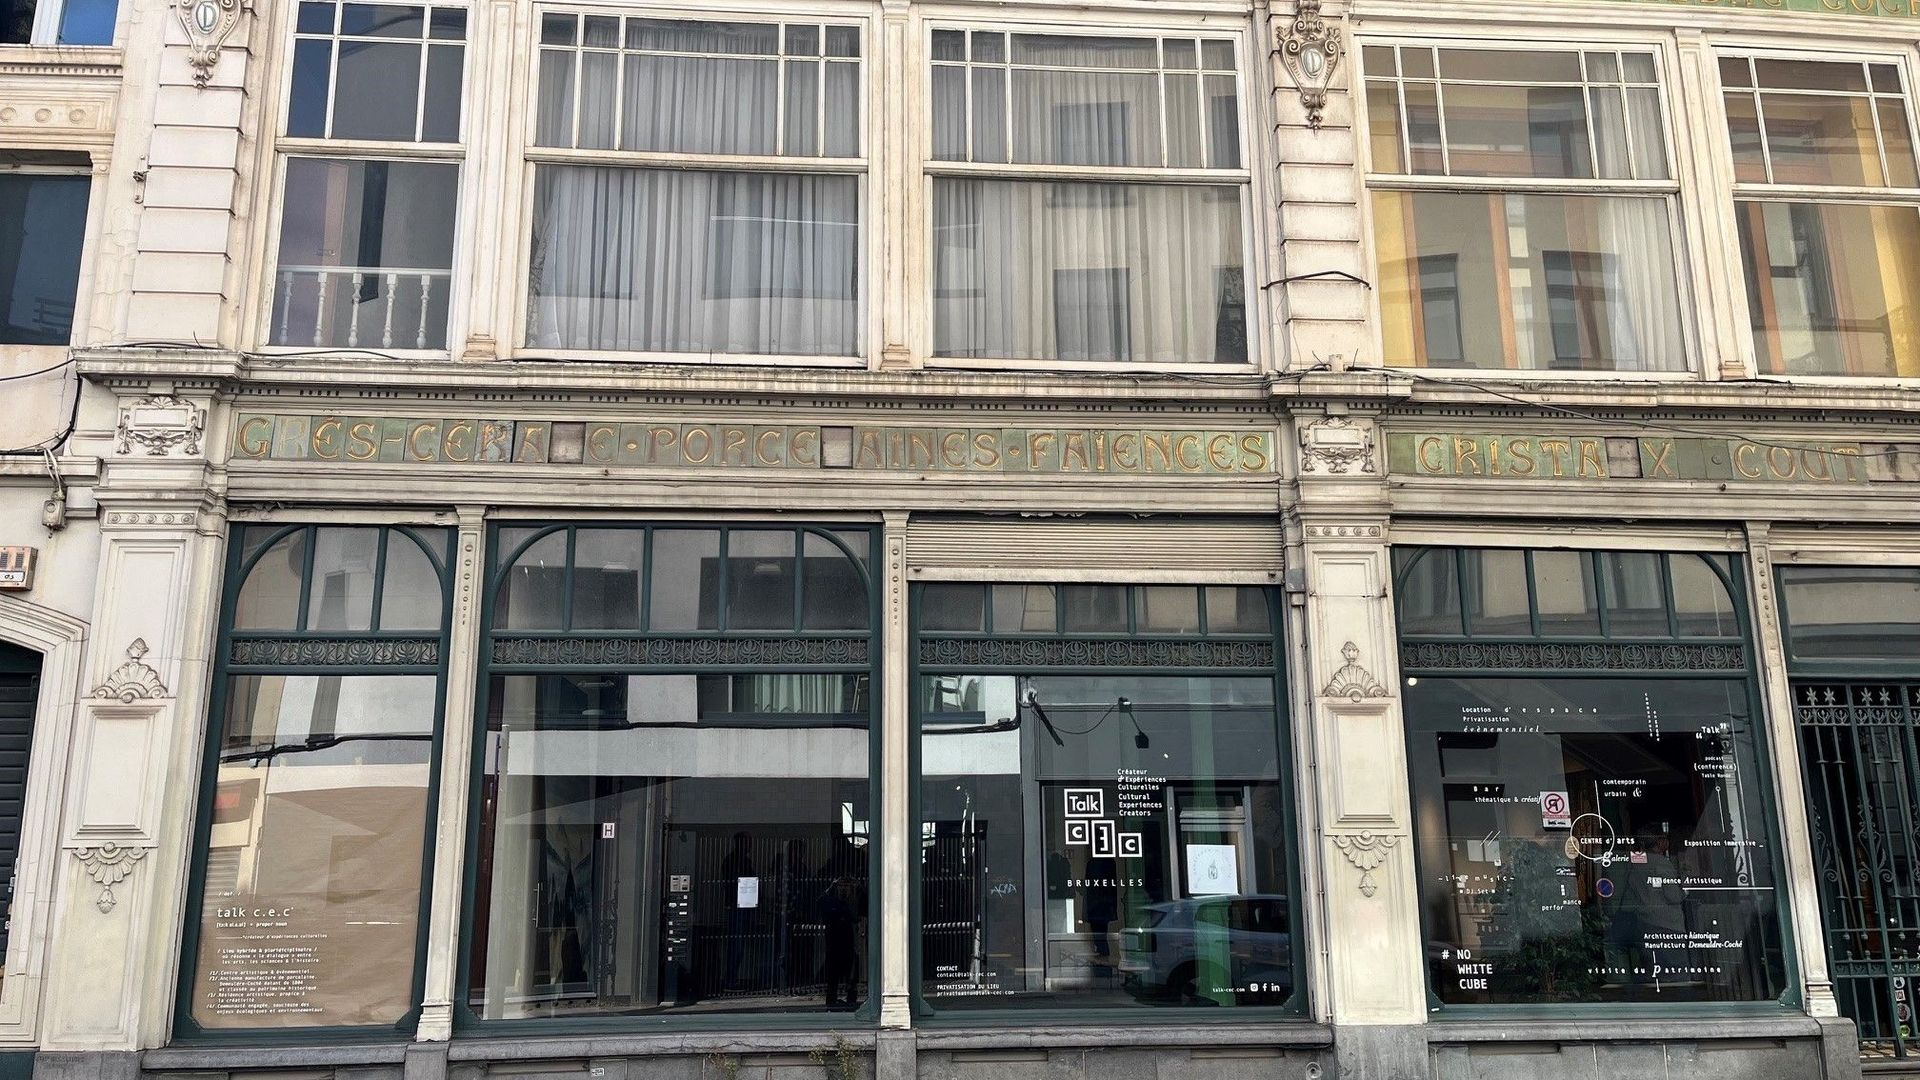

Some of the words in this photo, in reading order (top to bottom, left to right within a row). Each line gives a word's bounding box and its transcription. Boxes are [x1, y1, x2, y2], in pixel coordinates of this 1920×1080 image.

[648, 427, 1000, 469] PORCEAINES
[1028, 430, 1269, 472] FAÏENCES
[1418, 436, 1675, 479] CRISTAX
[1733, 443, 1860, 482] COUT
[1069, 794, 1099, 812] Talk
[1118, 801, 1163, 809] Experiences
[1474, 796, 1511, 804] thématique
[1616, 837, 1635, 845] arts
[1684, 840, 1721, 848] Exposition
[1067, 879, 1144, 888] BRUXELLES
[1683, 876, 1723, 885] Artistique
[217, 907, 246, 918] talk
[1688, 931, 1720, 942] historique
[1456, 949, 1471, 960] NO
[1457, 963, 1494, 975] WHITE
[1587, 967, 1626, 975] visite
[1634, 967, 1646, 975] du
[1459, 978, 1488, 990] CUBE
